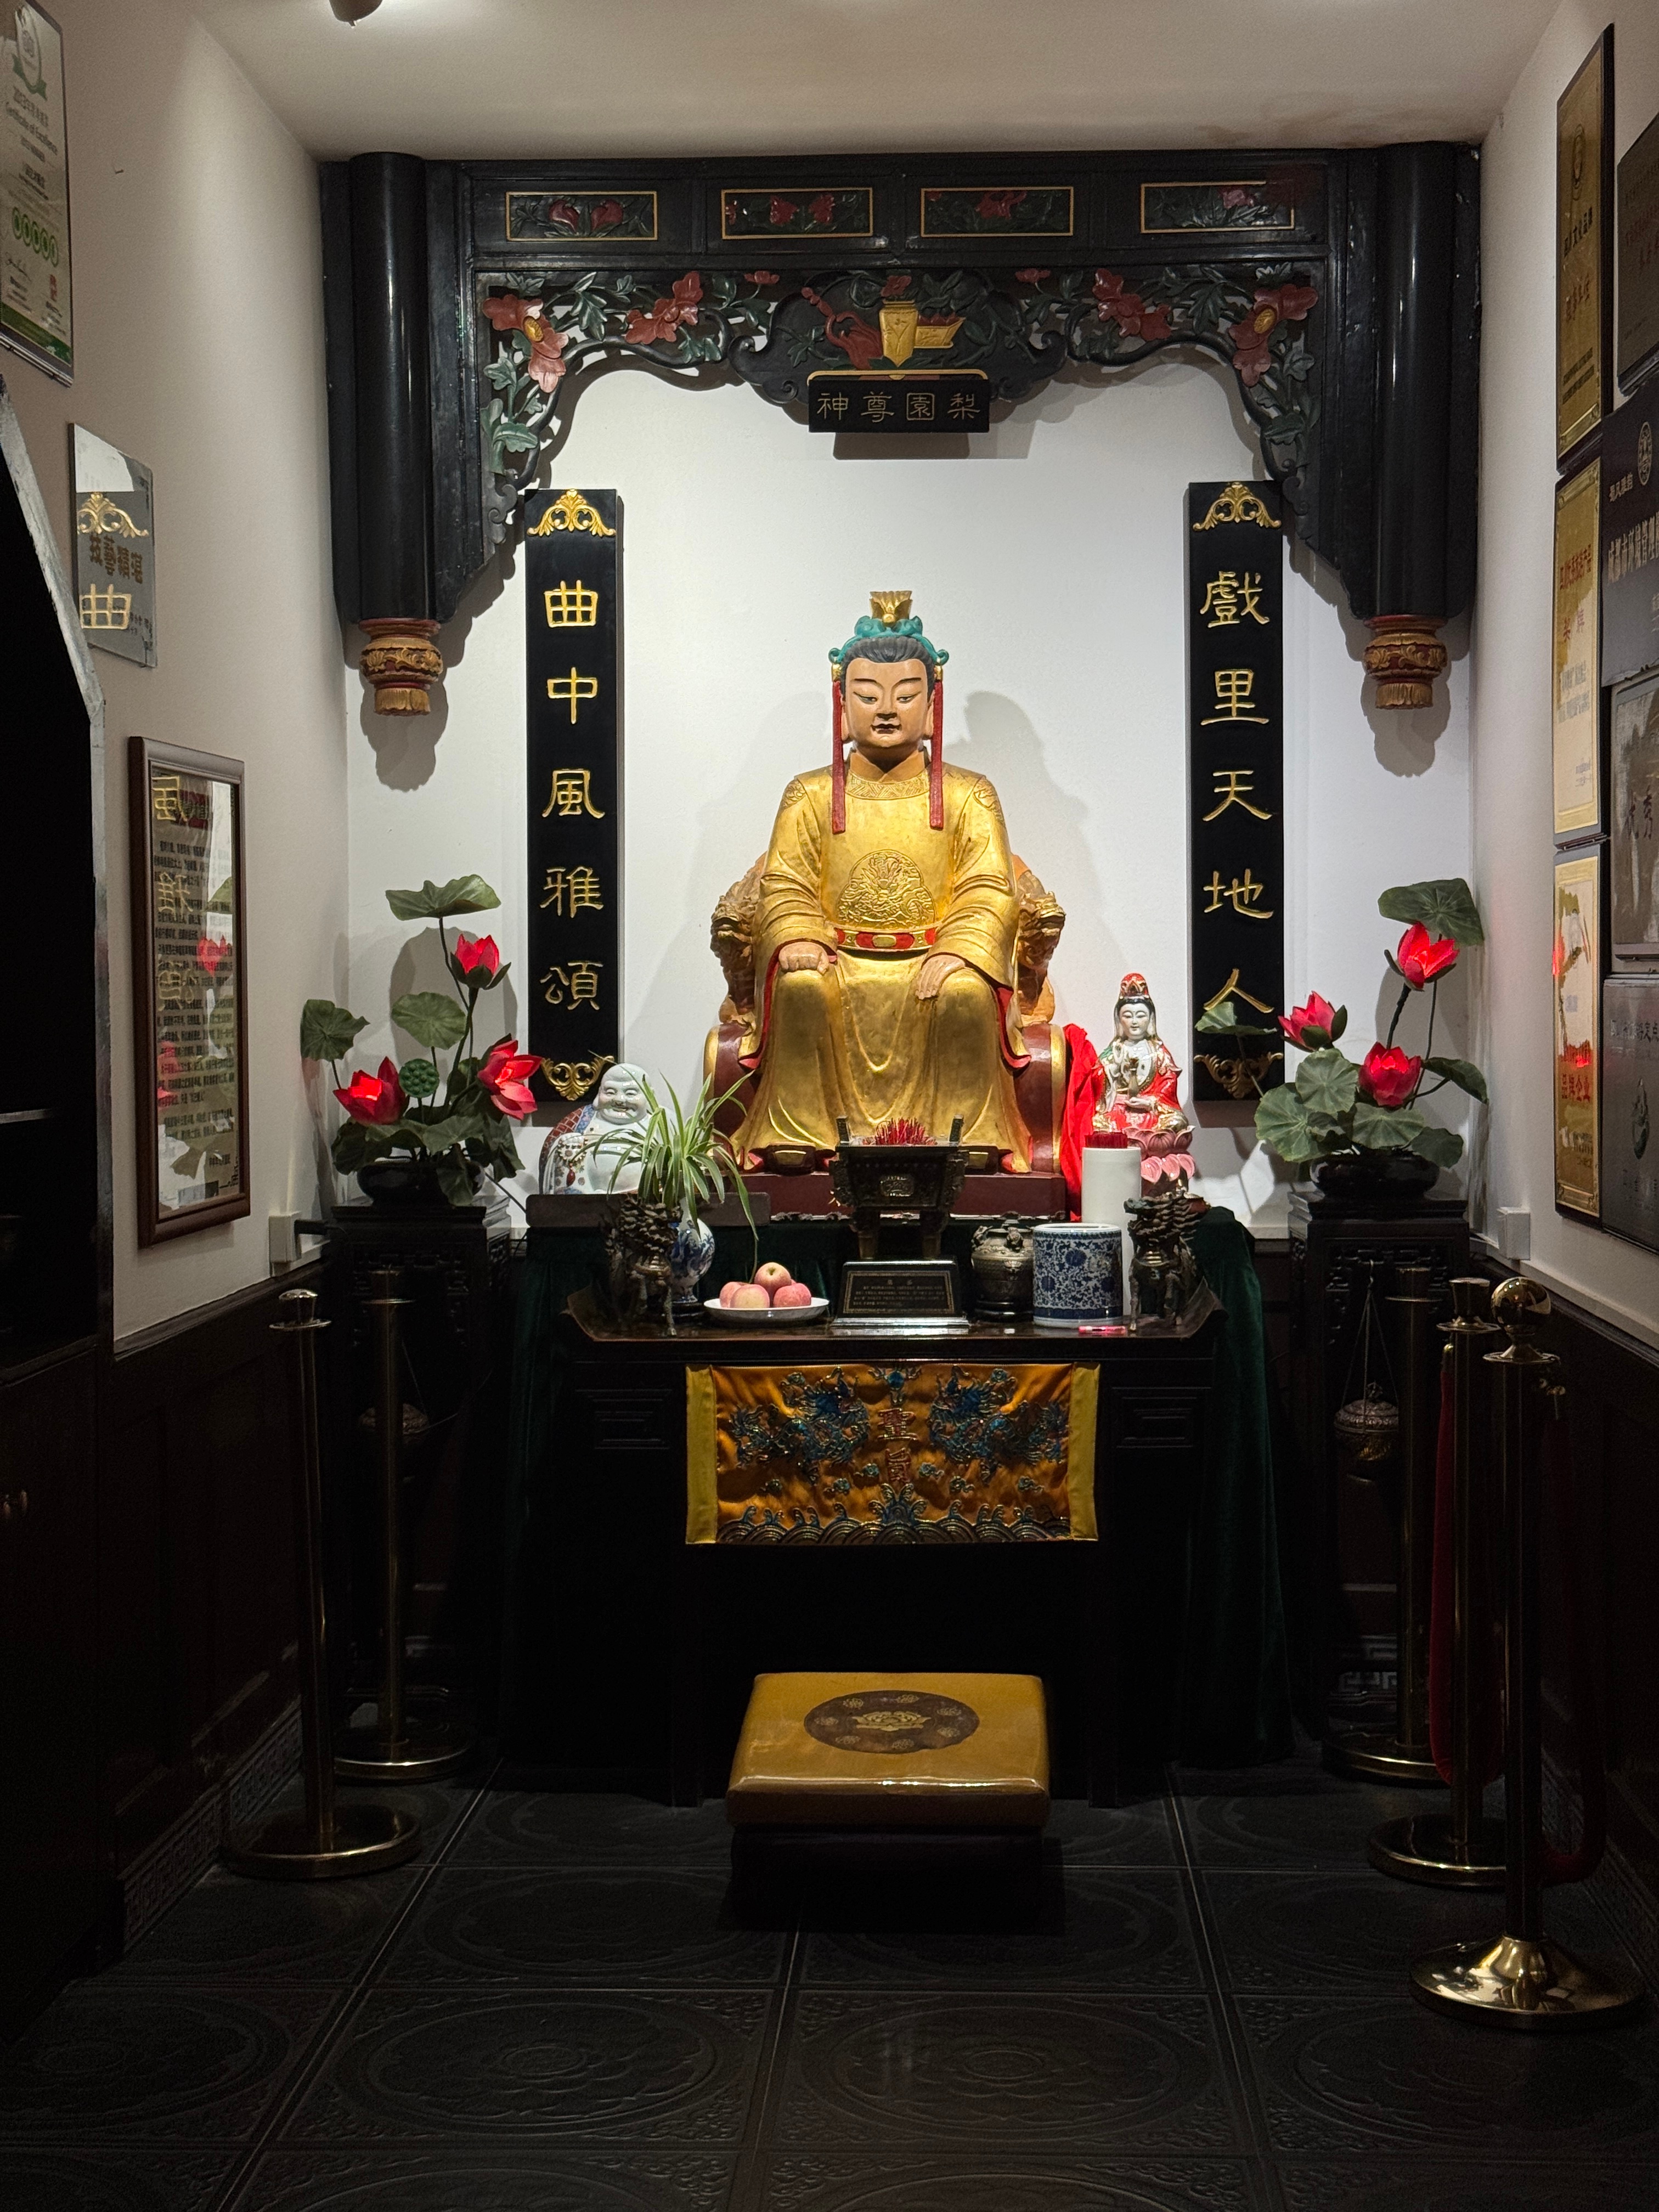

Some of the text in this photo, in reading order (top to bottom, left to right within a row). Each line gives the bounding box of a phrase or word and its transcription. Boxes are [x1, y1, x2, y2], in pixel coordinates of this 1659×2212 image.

[539, 579, 606, 1011] 曲中風雅頌
[1199, 571, 1275, 1014] 戲里天地人
